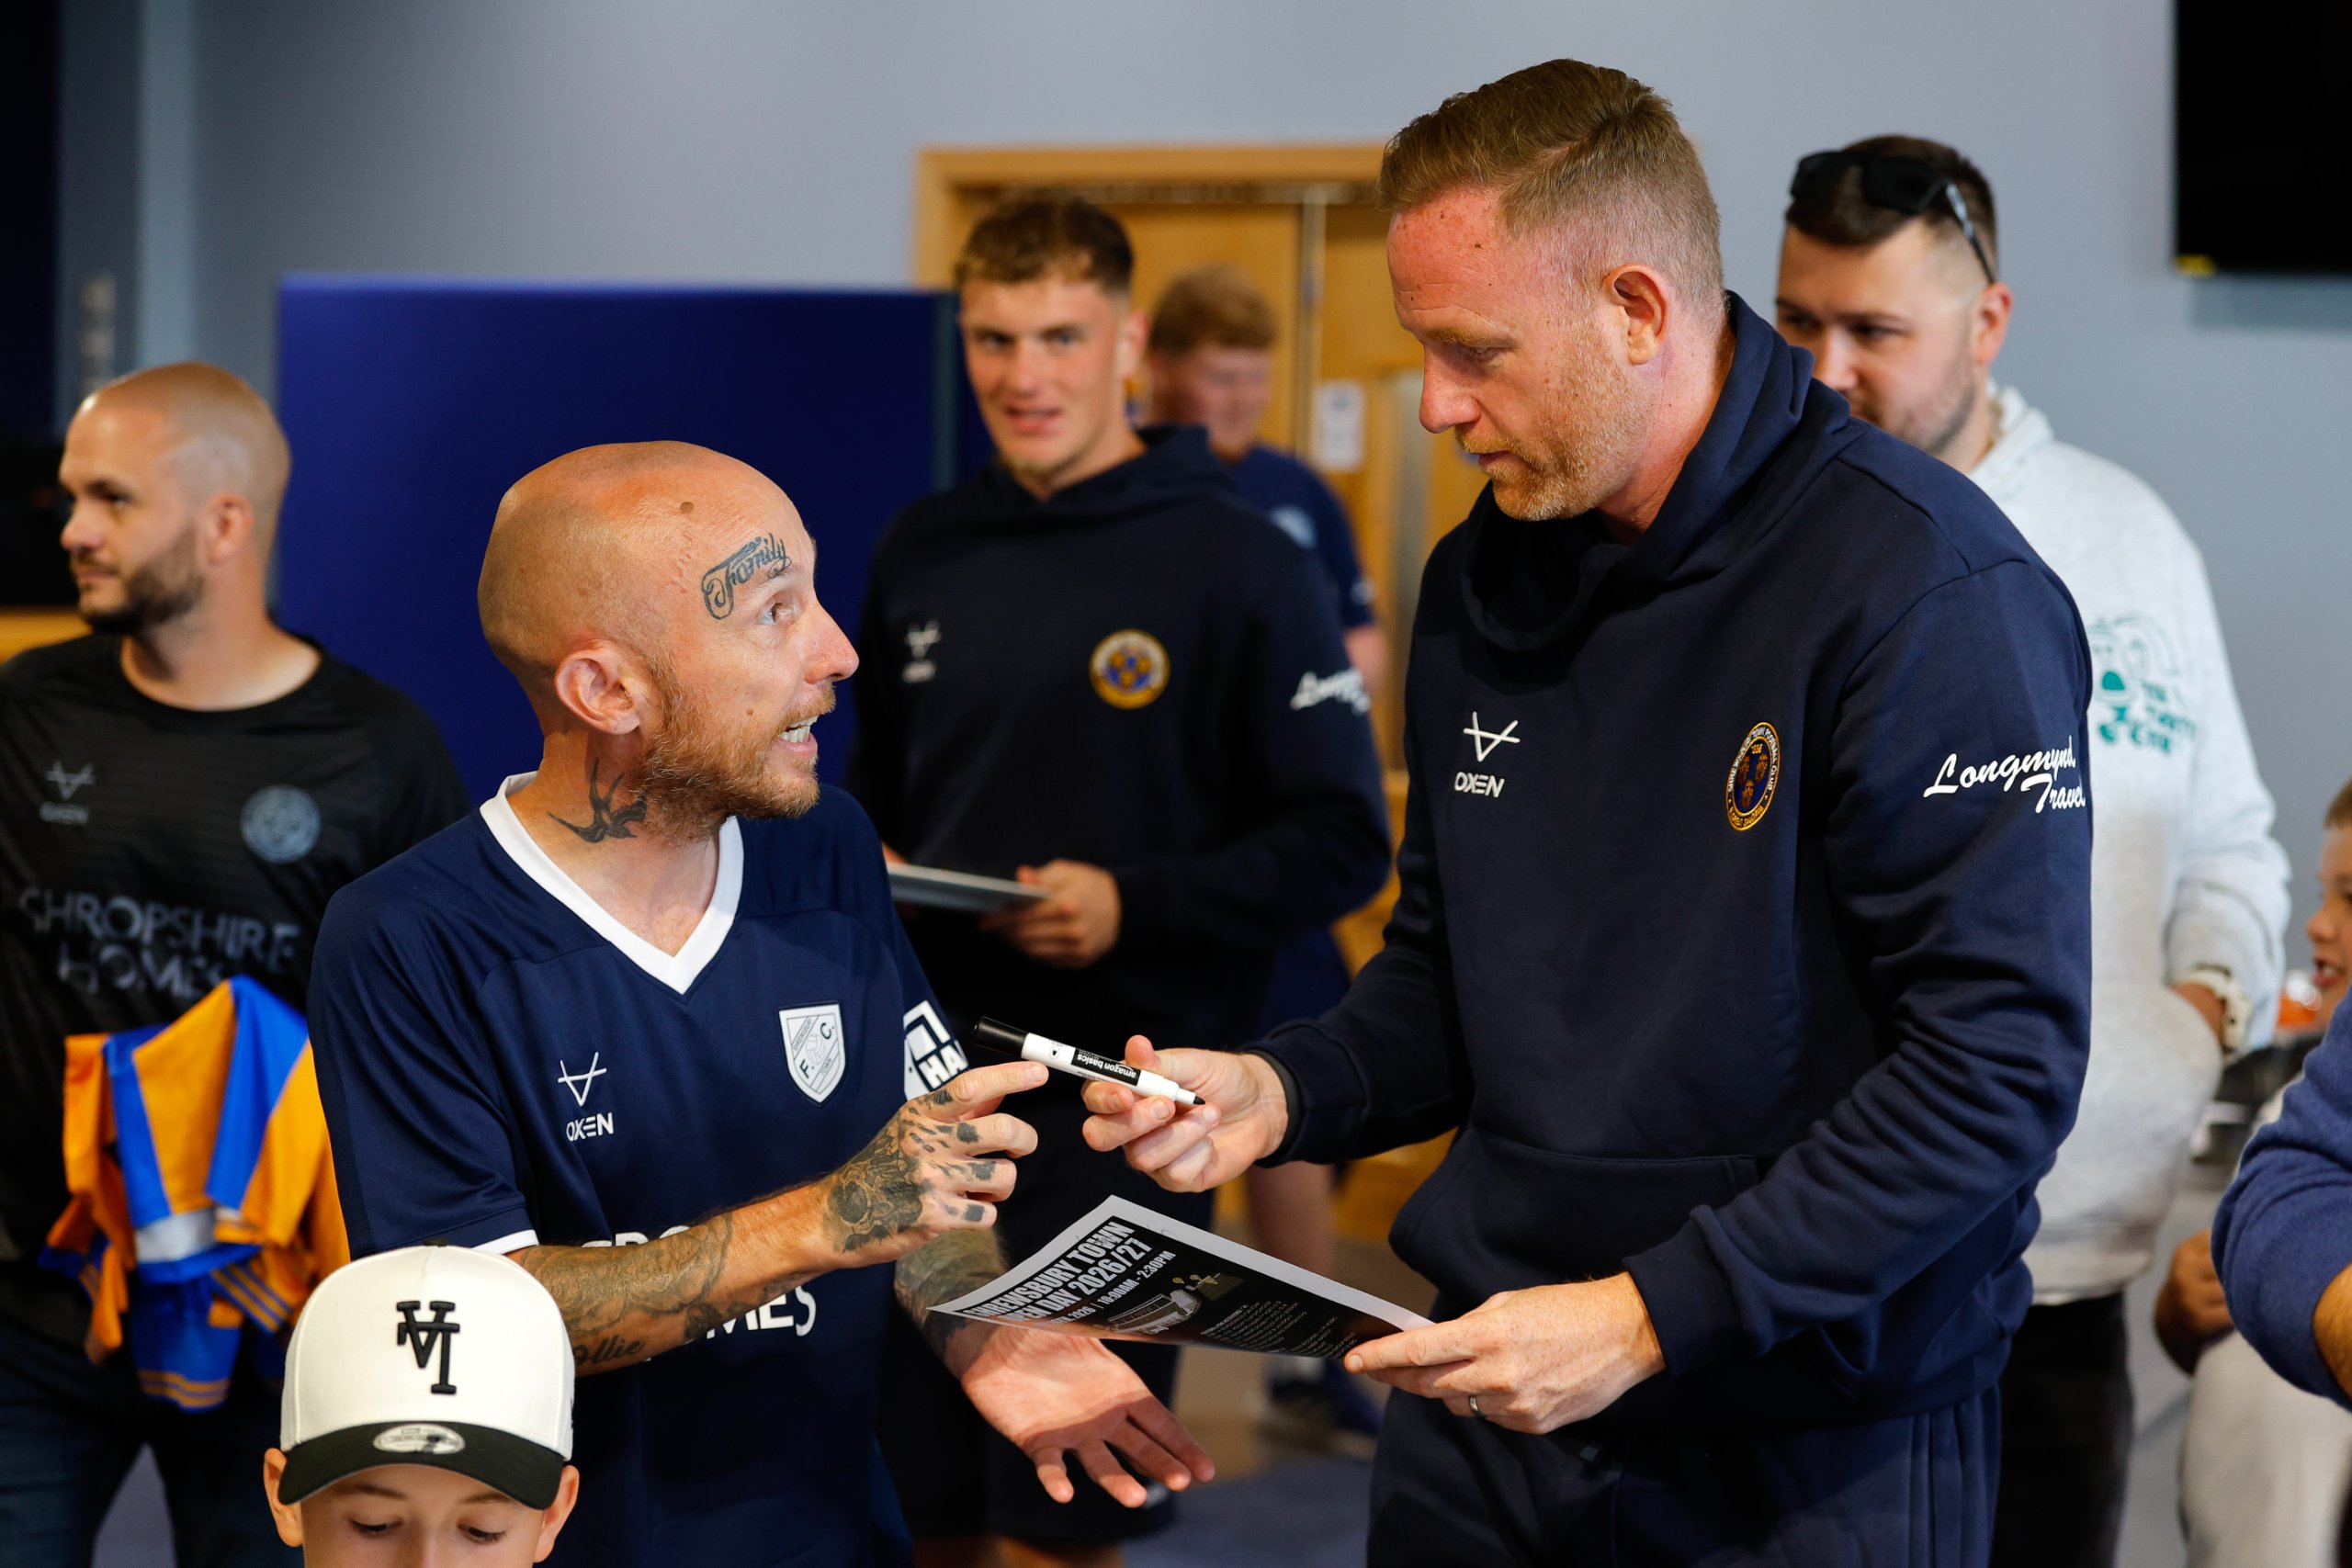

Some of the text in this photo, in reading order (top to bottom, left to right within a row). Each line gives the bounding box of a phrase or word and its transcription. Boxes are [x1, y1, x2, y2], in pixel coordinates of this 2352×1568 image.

[702, 533, 791, 619] Family
[1454, 772, 1505, 797] OXEN
[1923, 735, 2075, 797] Longmynd
[1077, 1054, 1103, 1070] basics
[1103, 1062, 1137, 1078] amazon
[566, 1112, 614, 1142] OXEN
[1066, 1221, 1135, 1265] TOWN
[1035, 1288, 1082, 1312] DAY
[1068, 1237, 1152, 1295] 2026/27
[1097, 1279, 1140, 1304] 10:00AM
[1136, 1250, 1177, 1279] 2:30PM
